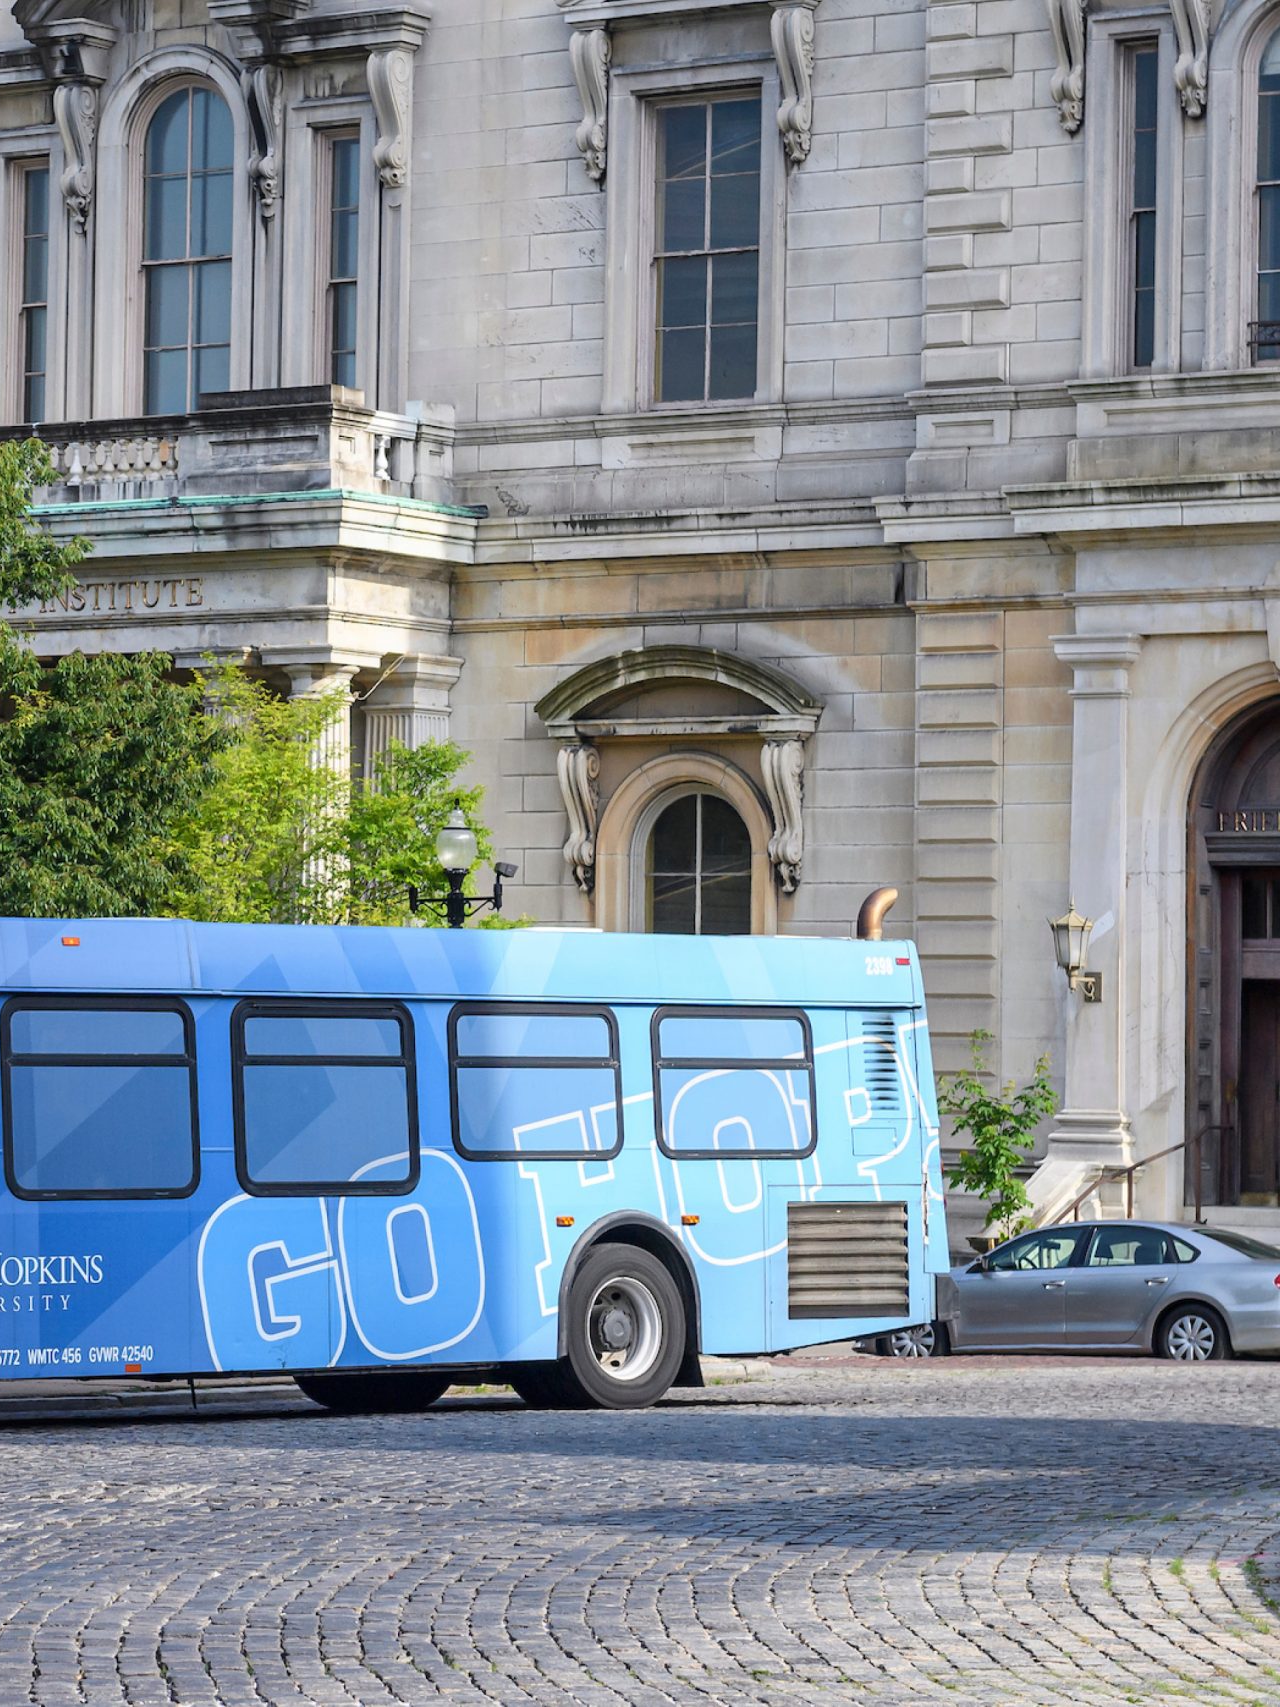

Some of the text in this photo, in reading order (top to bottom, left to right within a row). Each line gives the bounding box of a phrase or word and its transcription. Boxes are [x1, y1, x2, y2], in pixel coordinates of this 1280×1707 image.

[1217, 811, 1280, 832] FRIE
[865, 957, 893, 975] 2398
[197, 1148, 485, 1372] GO
[27, 1348, 59, 1365] WMTC
[61, 1347, 81, 1364] 456
[88, 1346, 119, 1363] GVWR
[121, 1345, 154, 1362] 42540
